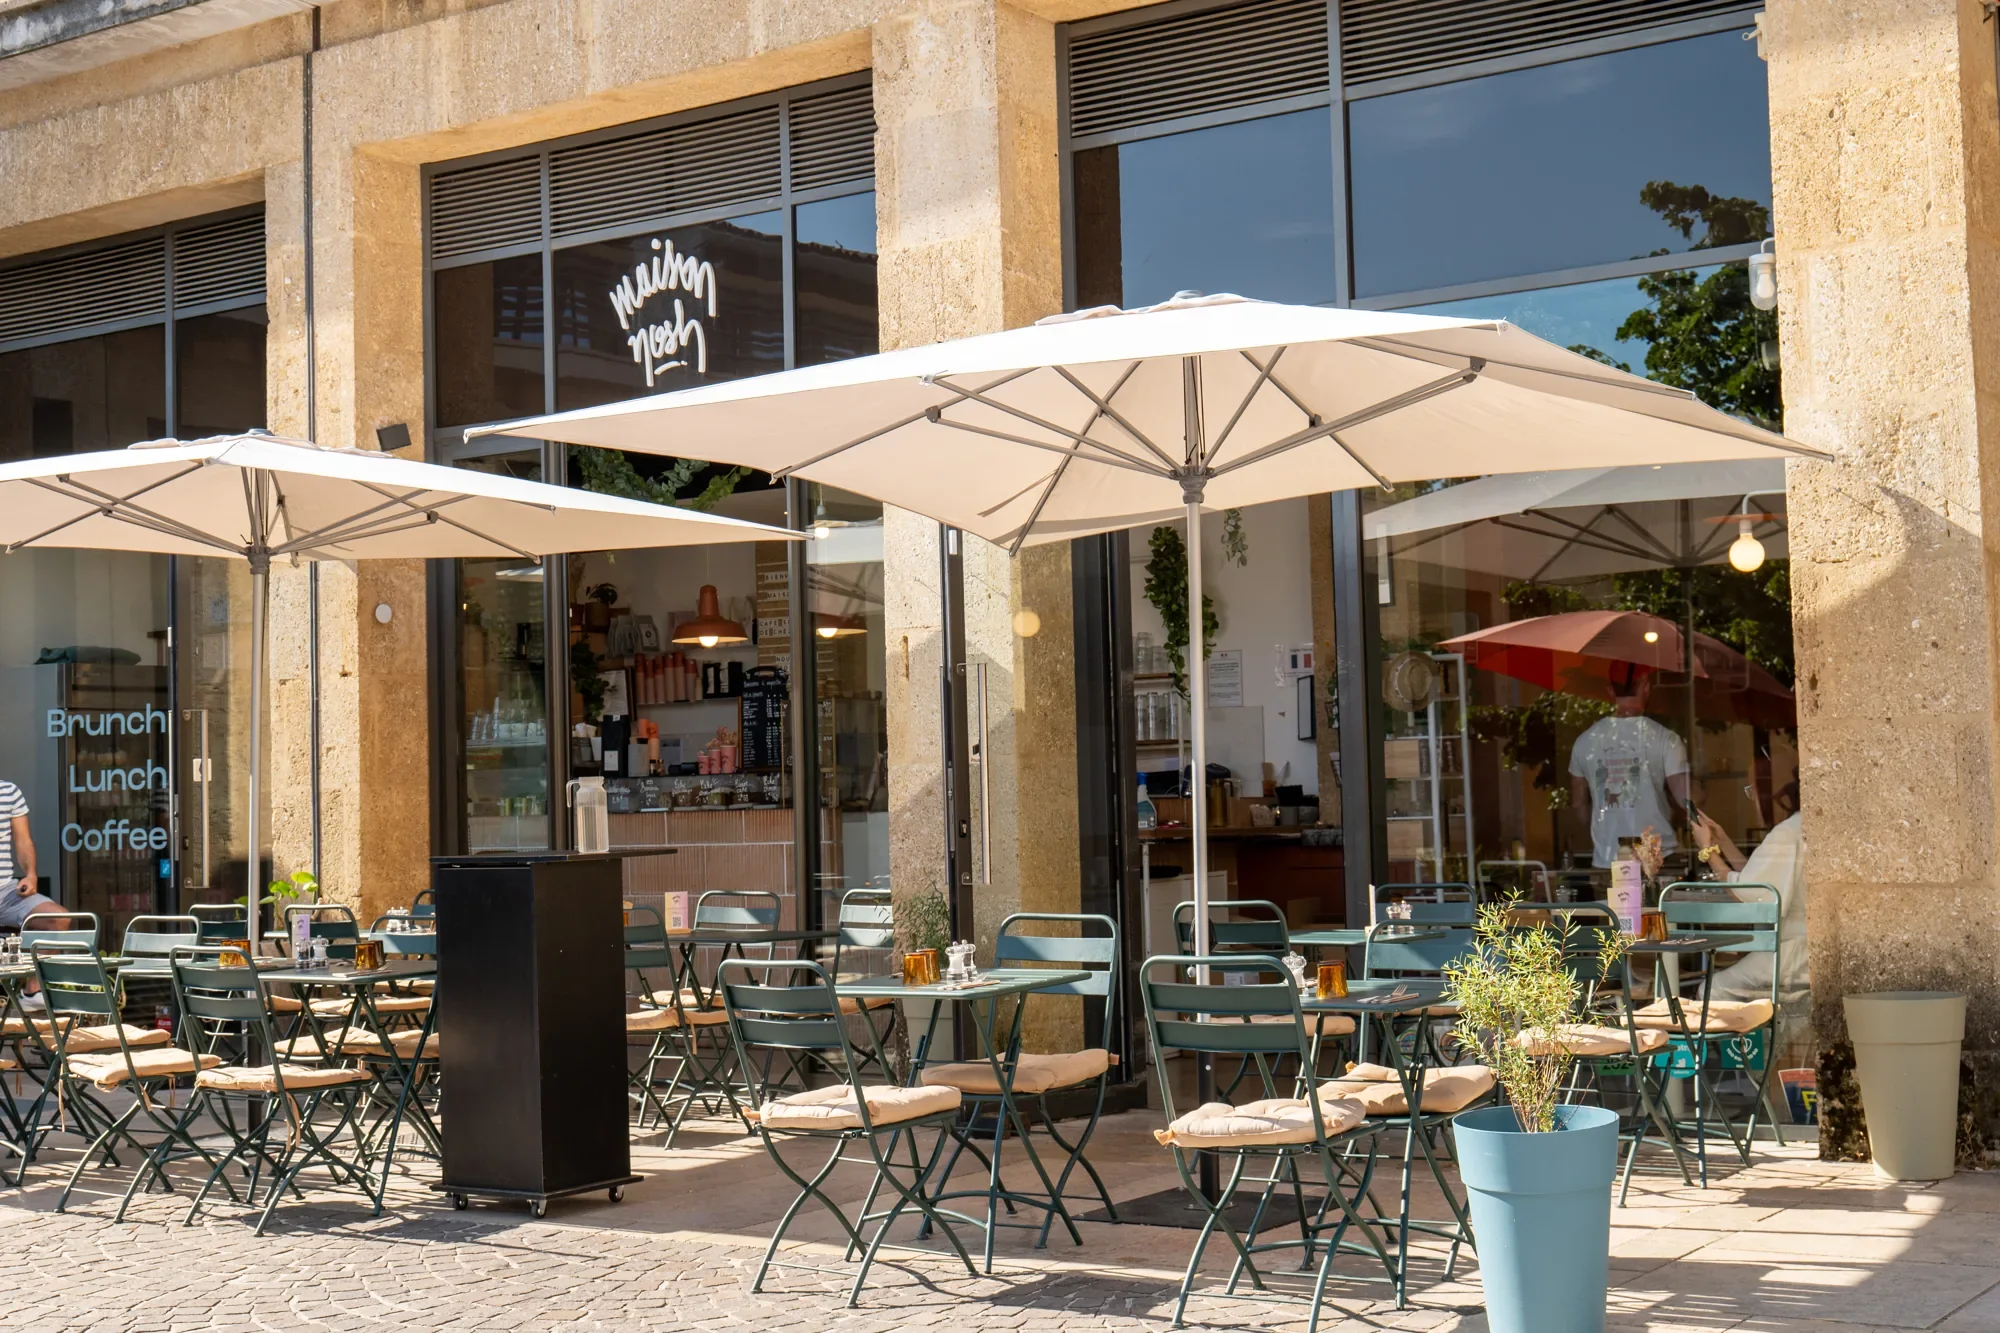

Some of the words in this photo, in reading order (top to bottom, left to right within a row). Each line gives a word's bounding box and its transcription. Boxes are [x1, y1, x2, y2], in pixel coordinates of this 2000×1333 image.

[609, 238, 717, 330] maison
[627, 298, 707, 387] nosh
[47, 703, 166, 738] Brunch
[69, 759, 167, 793] Lunch
[61, 819, 168, 852] Coffee
